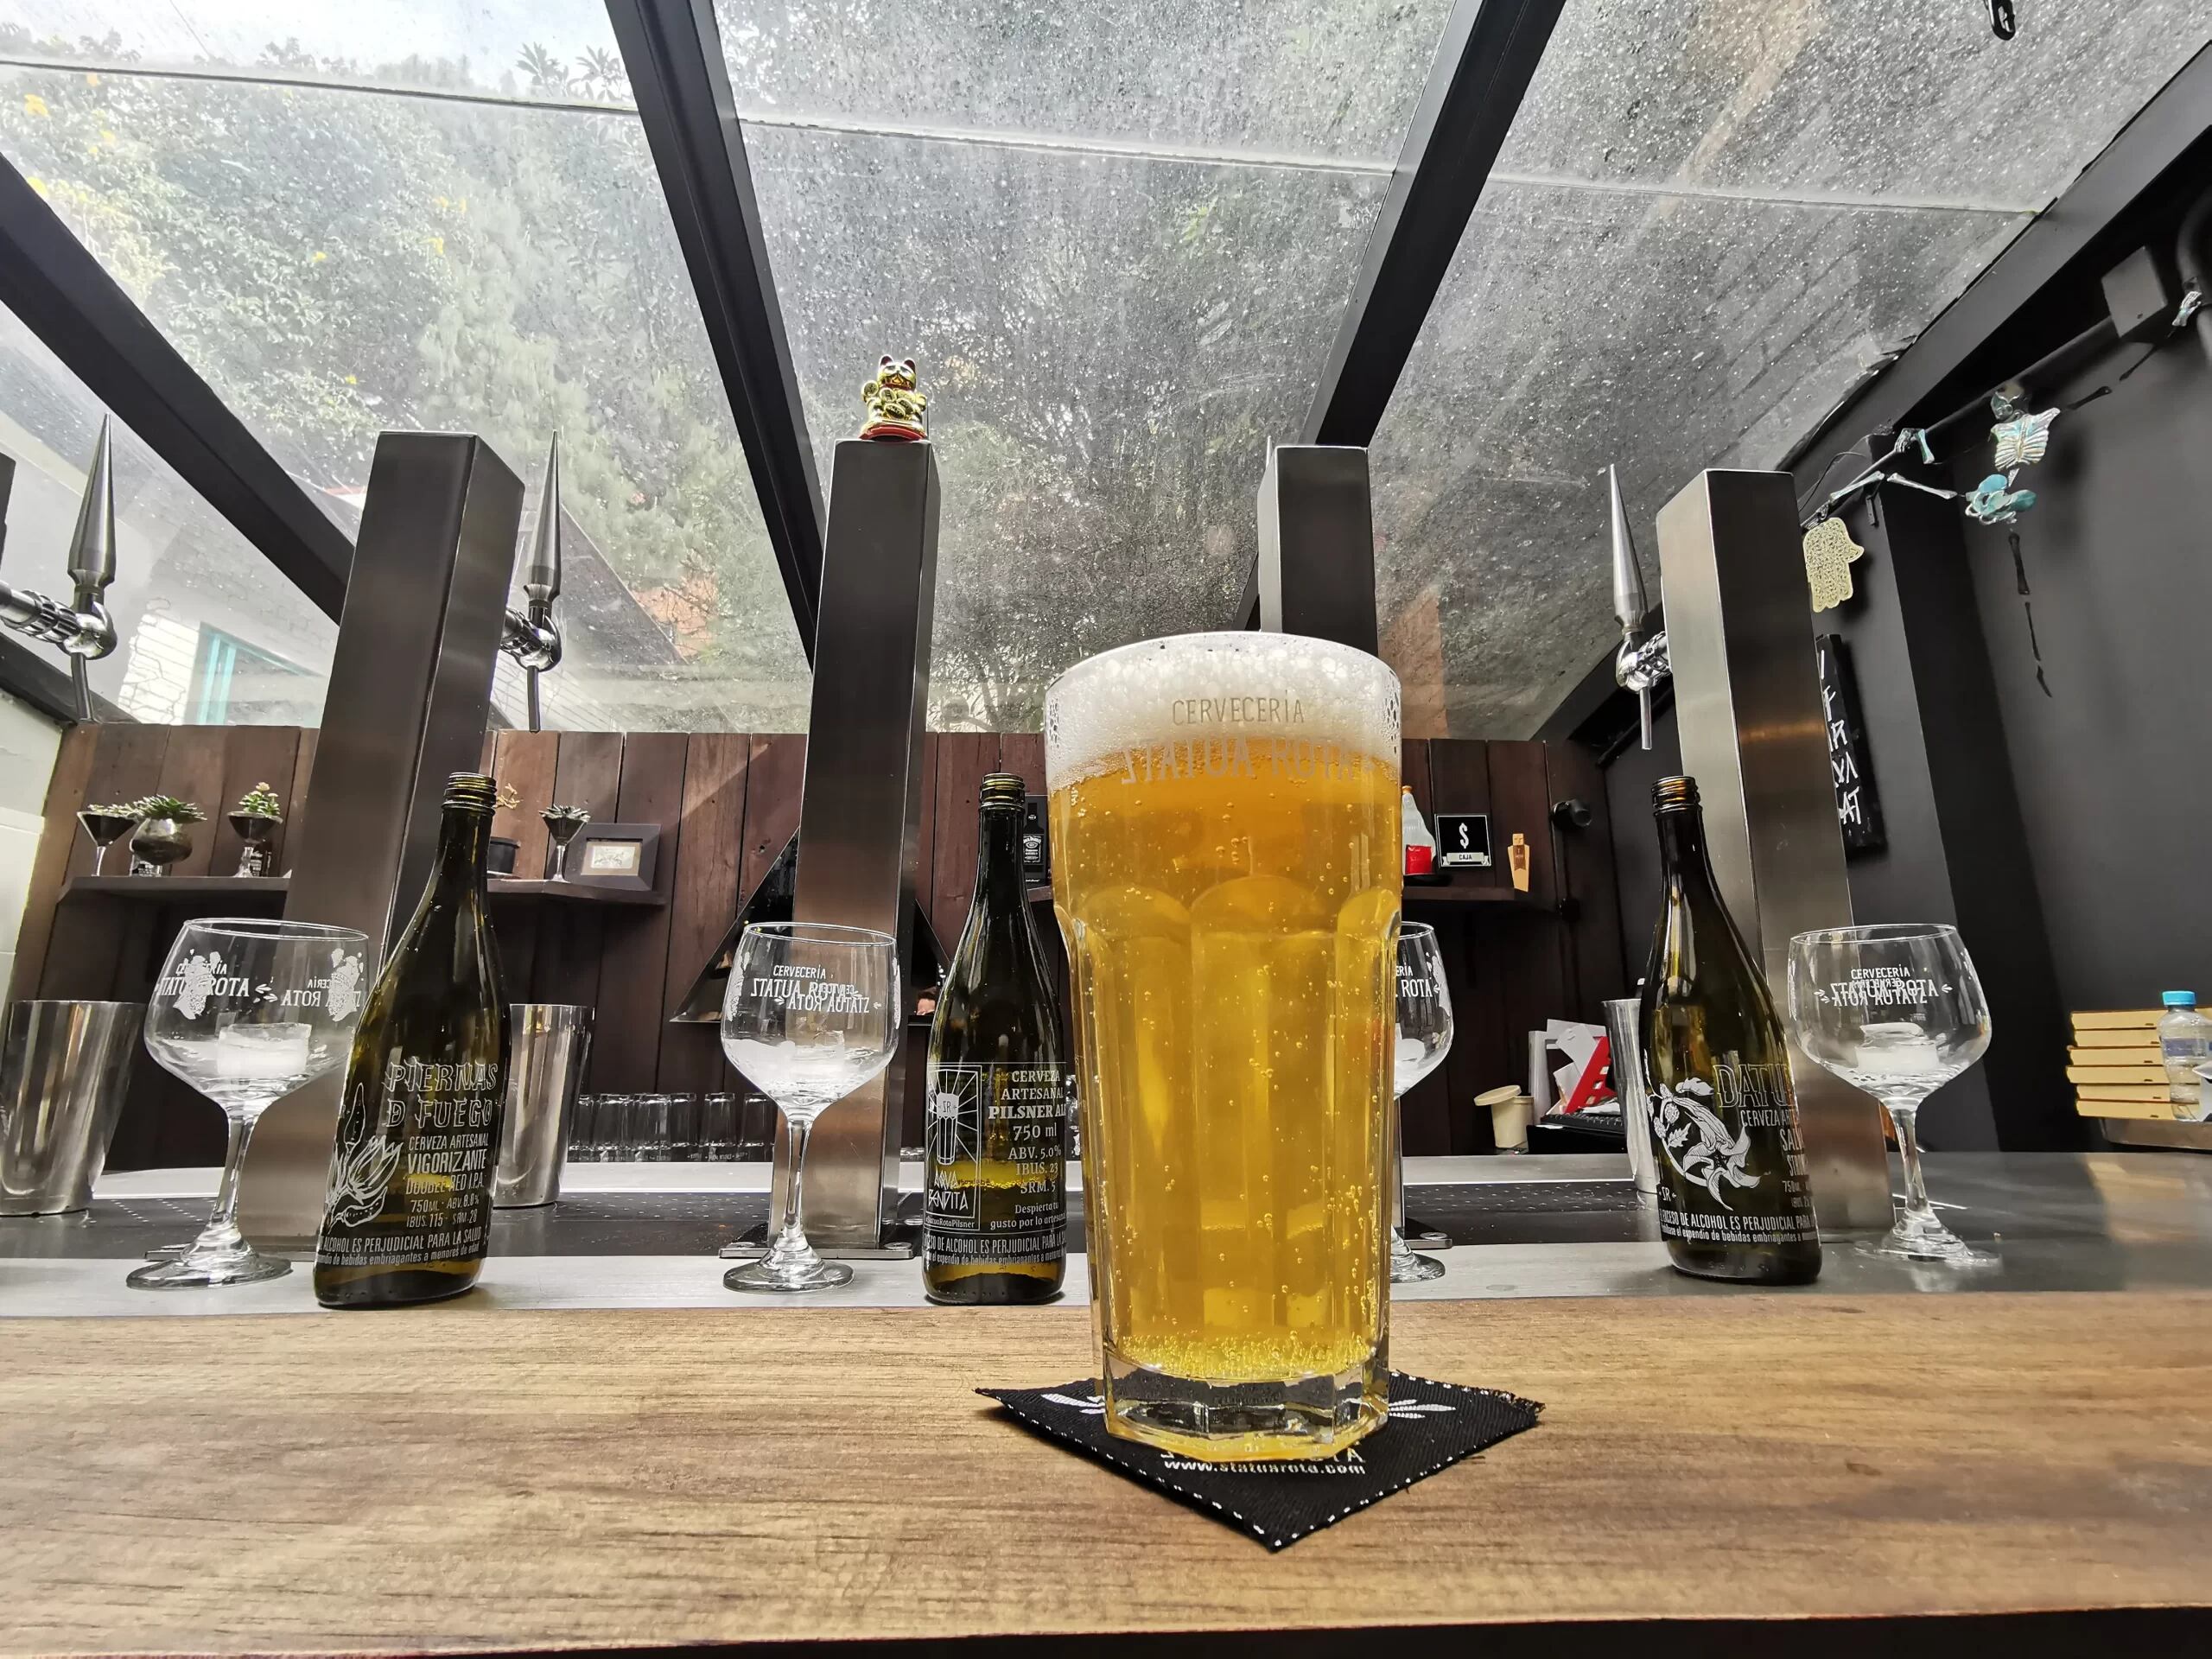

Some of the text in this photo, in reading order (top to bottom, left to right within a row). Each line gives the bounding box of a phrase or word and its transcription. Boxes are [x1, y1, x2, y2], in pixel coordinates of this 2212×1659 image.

[1173, 690, 1305, 726] CERVECERÍA
[773, 964, 826, 979] CERVECERÍA
[1851, 964, 1910, 980] CERVECERÍA
[1401, 979, 1433, 997] ROTA
[1012, 1070, 1060, 1083] CERVEZA
[1001, 1087, 1064, 1100] ARTESANAL
[415, 1095, 493, 1128] FUEGO
[988, 1105, 1053, 1120] PILSNER
[1740, 1109, 1780, 1127] CERVEZA
[1013, 1122, 1057, 1141] 750 ml
[409, 1133, 489, 1151] CERVEZA ARTESANAL
[1008, 1144, 1062, 1160] ABV. 5.0%
[408, 1149, 487, 1174] VIGORIZANTE
[1020, 1180, 1056, 1194] SRM. 5
[1014, 1203, 1052, 1215] Despierta
[990, 1218, 1017, 1230] gusto
[1020, 1217, 1034, 1230] por
[1036, 1216, 1043, 1225] lo
[1680, 1212, 1690, 1227] DE
[1691, 1213, 1728, 1230] ALCOHOL
[1729, 1216, 1741, 1230] ES
[1742, 1216, 1796, 1230] PERJUDICIAL
[323, 1236, 349, 1252] ALCOHOL
[352, 1237, 362, 1253] ES
[365, 1236, 423, 1252] PERJUDICIAL
[428, 1232, 450, 1249] PARA
[453, 1230, 461, 1245] LA
[938, 1236, 945, 1251] DE
[946, 1237, 977, 1254] ALCOHOL
[980, 1239, 989, 1254] ES
[992, 1236, 1040, 1255] PERJUDICIAL
[1682, 1229, 1709, 1241] expendio
[1711, 1230, 1720, 1241] de
[1721, 1230, 1751, 1243] bebidas
[1752, 1231, 1797, 1244] embriagantes
[341, 1254, 367, 1266] bebidas
[369, 1252, 422, 1266] embriagantes
[423, 1253, 429, 1262] a
[431, 1248, 459, 1260] menores
